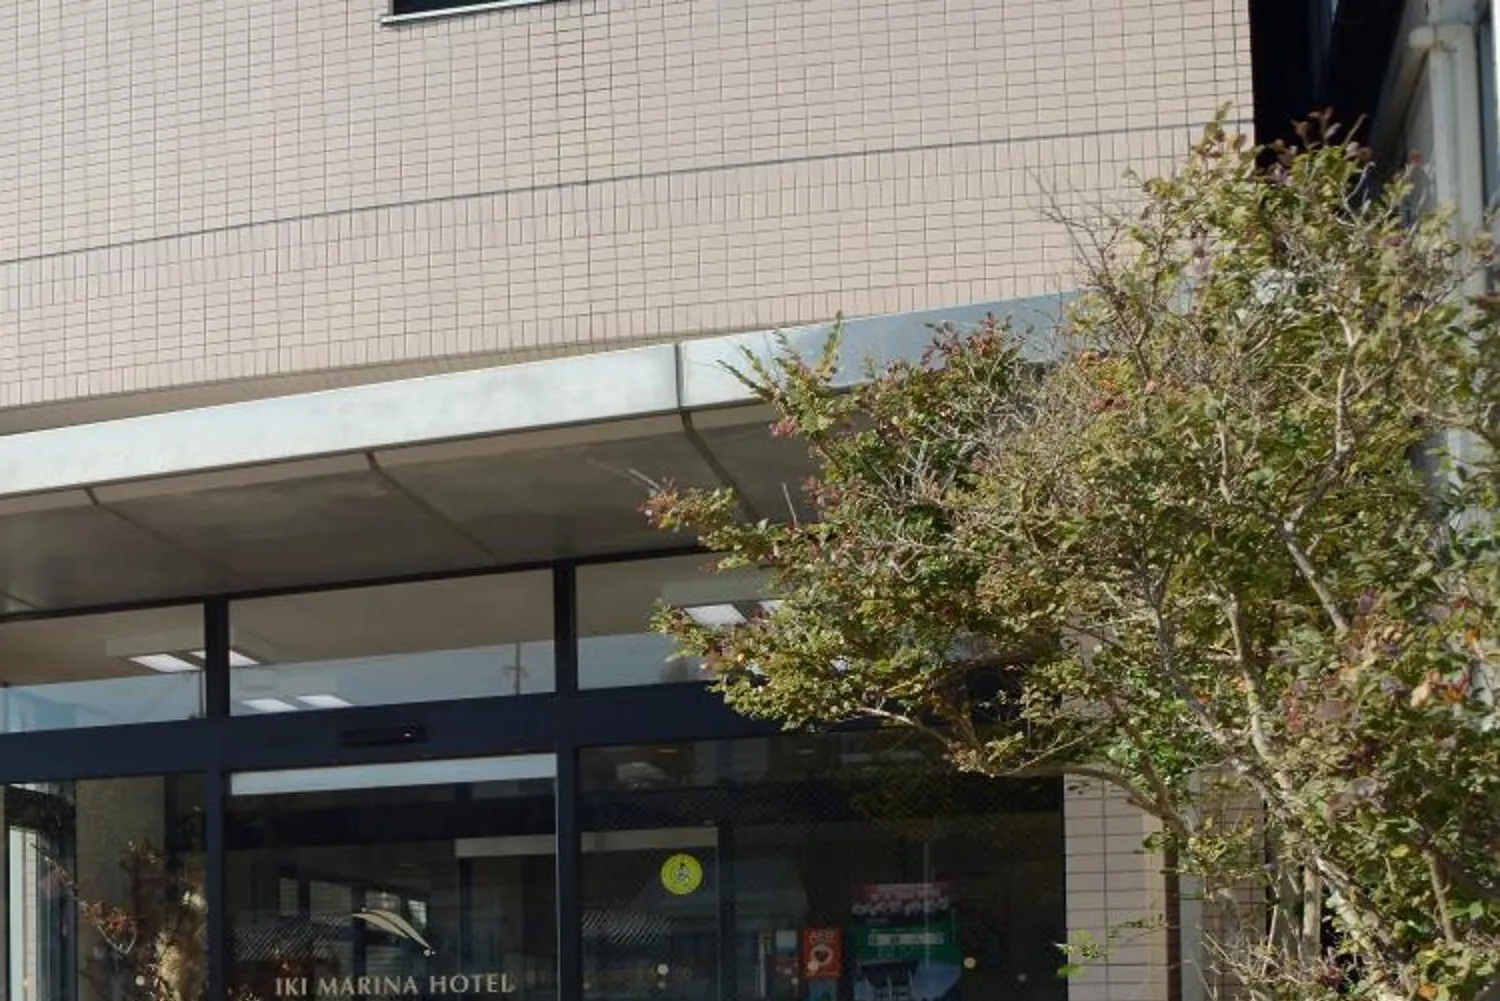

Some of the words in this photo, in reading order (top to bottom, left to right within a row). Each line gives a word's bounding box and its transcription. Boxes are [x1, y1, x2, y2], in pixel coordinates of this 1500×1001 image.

[275, 977, 307, 997] IKI
[317, 976, 418, 996] MARINA
[430, 973, 514, 994] HOTEL
